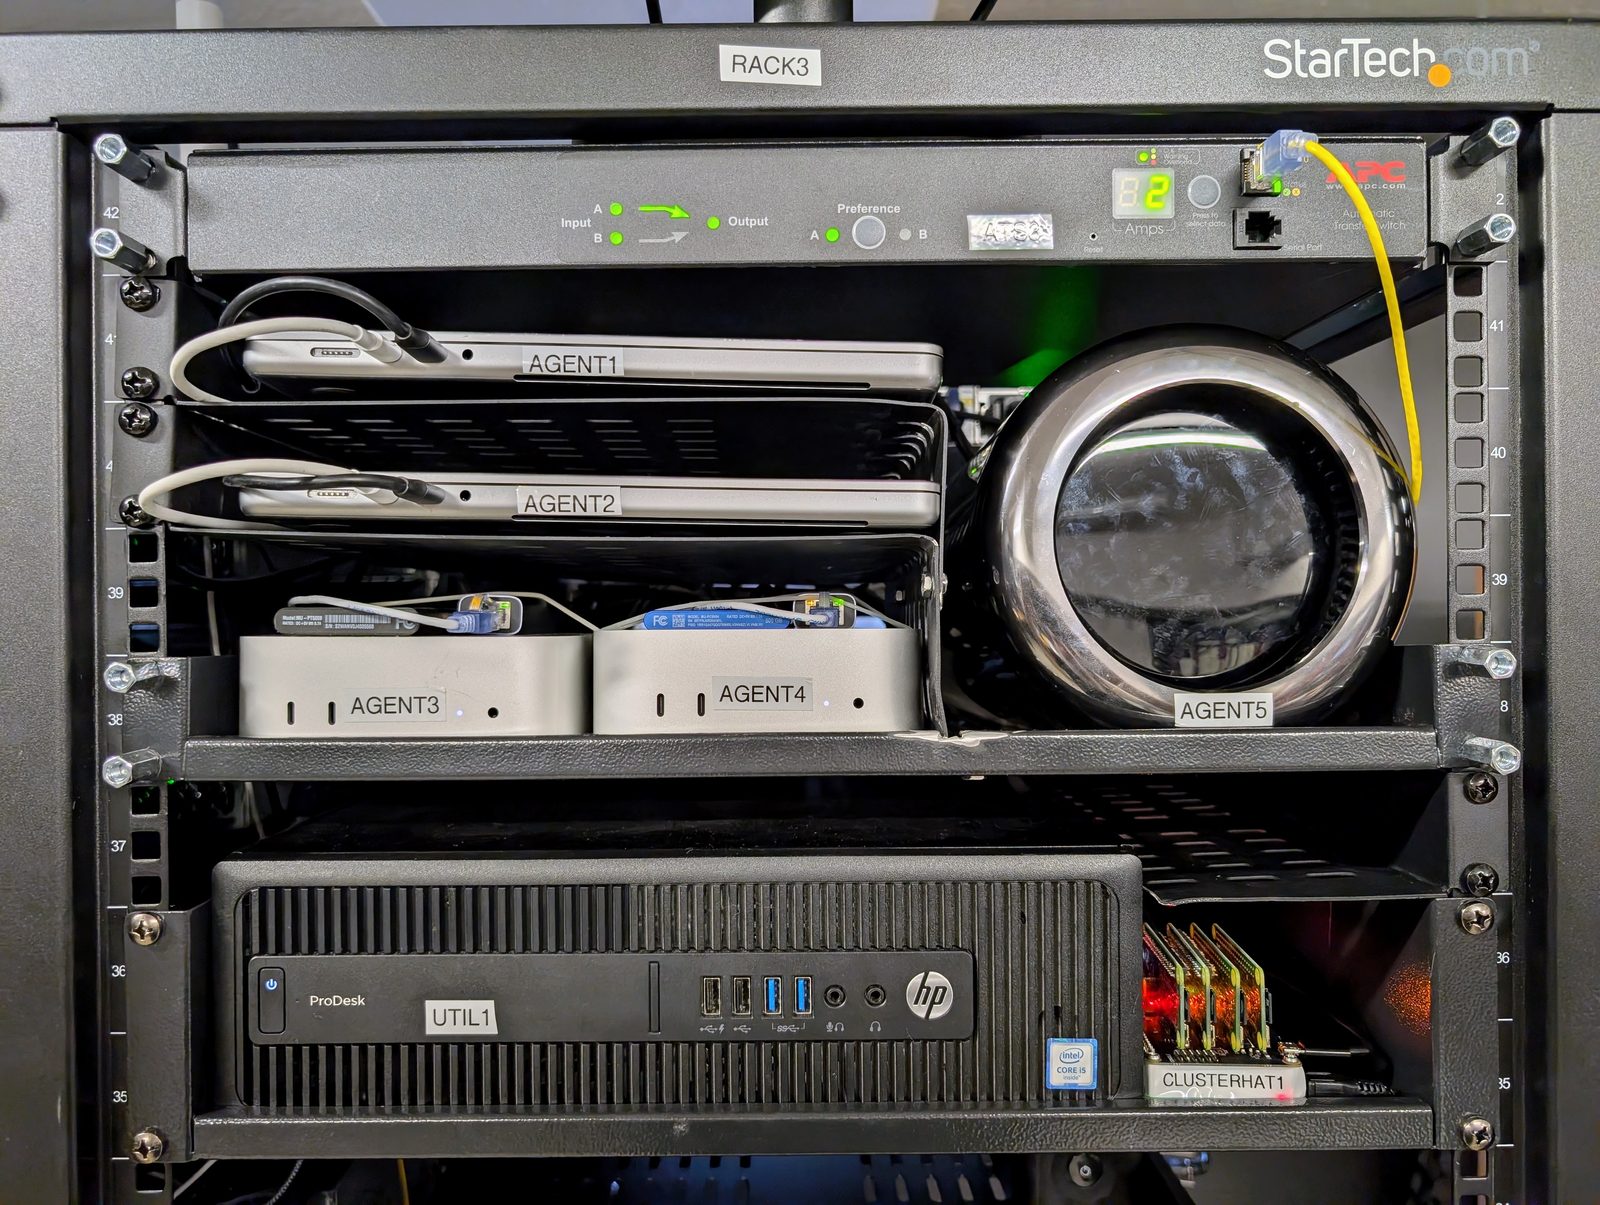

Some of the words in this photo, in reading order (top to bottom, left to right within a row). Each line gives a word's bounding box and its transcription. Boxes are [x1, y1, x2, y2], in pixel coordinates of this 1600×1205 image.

[731, 54, 809, 77] RACK3
[1496, 193, 1505, 205] 2
[103, 207, 120, 219] 42
[593, 203, 603, 214] A
[837, 203, 901, 214] Preference
[561, 217, 592, 230] Input
[728, 216, 769, 228] Output
[810, 230, 819, 240] A
[919, 229, 928, 240] B
[1124, 223, 1164, 236] Amps
[594, 233, 603, 244] B
[1490, 319, 1504, 332] 41
[529, 354, 616, 374] AGENT1
[1490, 446, 1507, 459] 40
[524, 494, 615, 513] AGENT2
[1492, 573, 1508, 586] 39
[107, 587, 123, 599] 39
[719, 684, 806, 703] AGENT4
[350, 695, 440, 715] AGENT3
[1180, 701, 1267, 720] AGENT5
[1500, 700, 1509, 712] 8
[107, 713, 123, 726] 38
[110, 840, 126, 852] 37
[111, 965, 126, 977] 36
[310, 994, 366, 1006] ProDesk
[433, 1008, 490, 1027] UTIL1
[1062, 1051, 1080, 1060] intel
[1056, 1066, 1077, 1074] CORE
[1162, 1072, 1284, 1090] CLUSTERHAT1
[112, 1091, 127, 1103] 35
